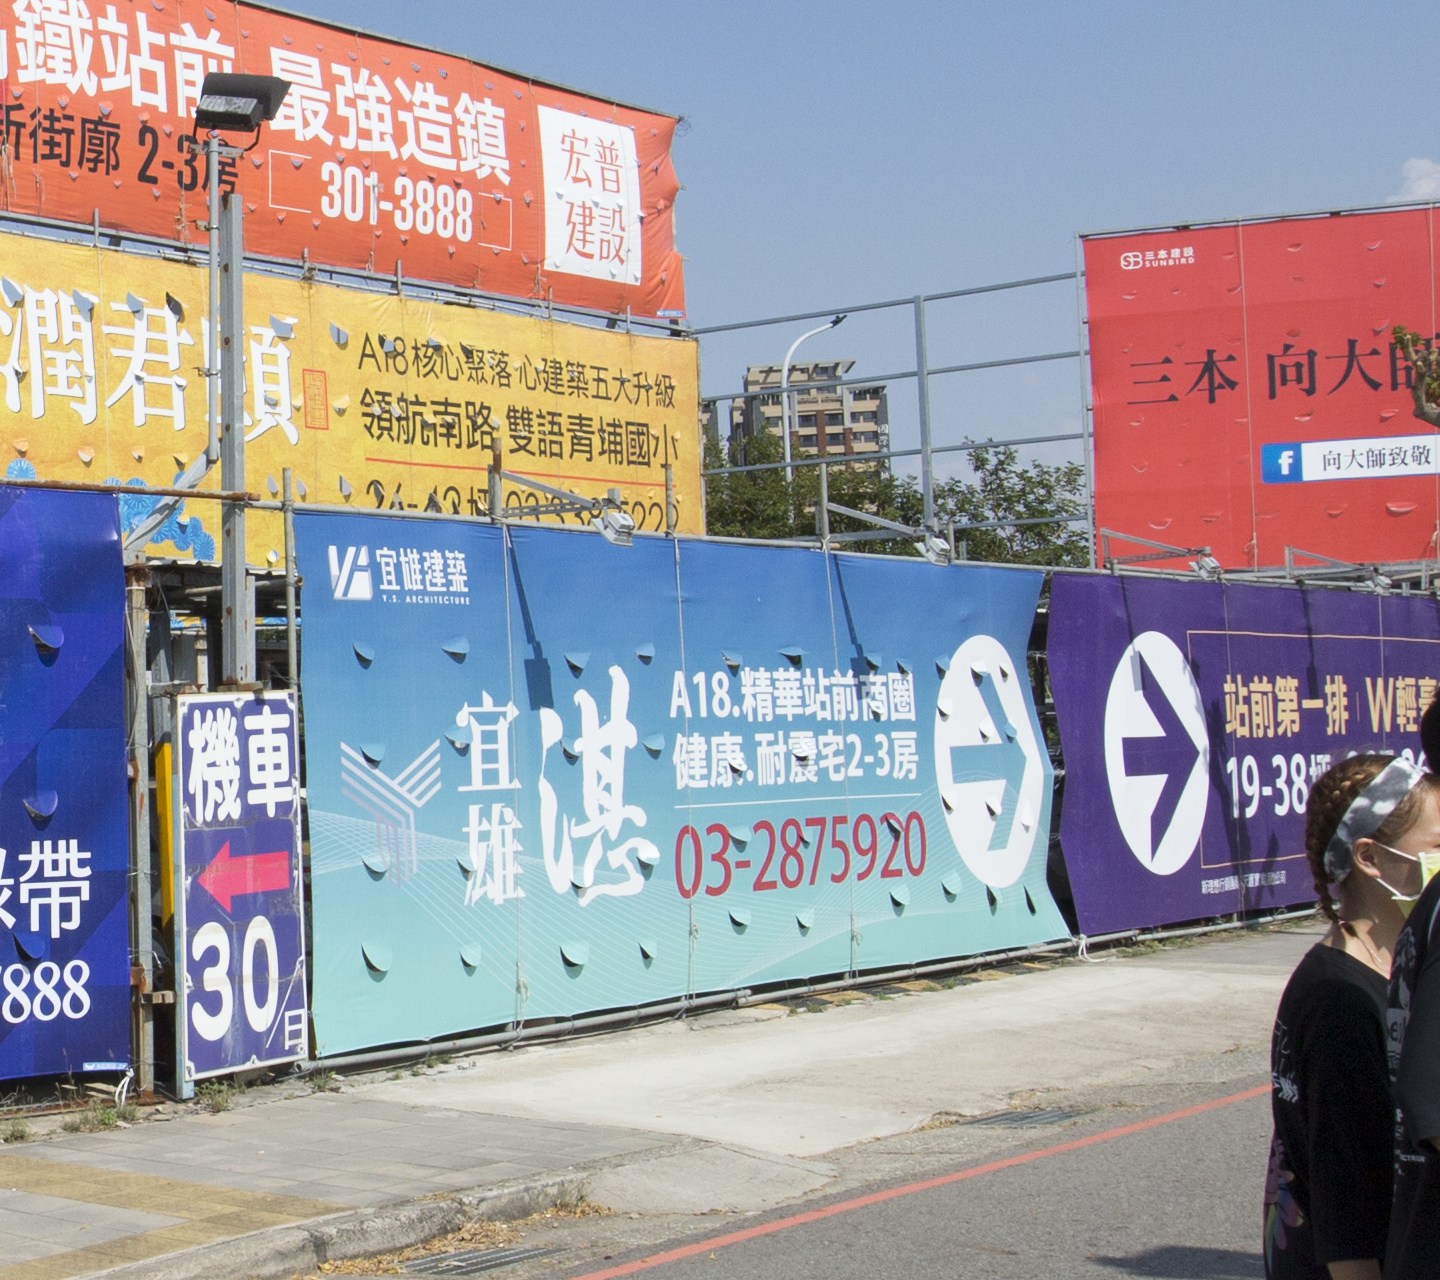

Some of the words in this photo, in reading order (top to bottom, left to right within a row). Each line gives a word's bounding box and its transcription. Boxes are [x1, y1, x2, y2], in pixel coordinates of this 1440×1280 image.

[268, 46, 512, 187] 最強造鎮
[560, 128, 624, 195] 宏普
[320, 161, 474, 243] 301-3888
[565, 200, 627, 267] 建設
[1145, 257, 1195, 268] SUNBIRD
[1126, 348, 1240, 405] 三本
[359, 387, 496, 452] 領航南路
[505, 403, 679, 469] 雙語青埔國小
[1321, 444, 1433, 473] 向大師致敬
[405, 595, 471, 605] ARCHITECTURE
[1222, 673, 1350, 739] 站前第一排
[187, 704, 296, 822] 機車
[455, 690, 525, 909] 宜雄
[674, 810, 928, 900] 03-2875920
